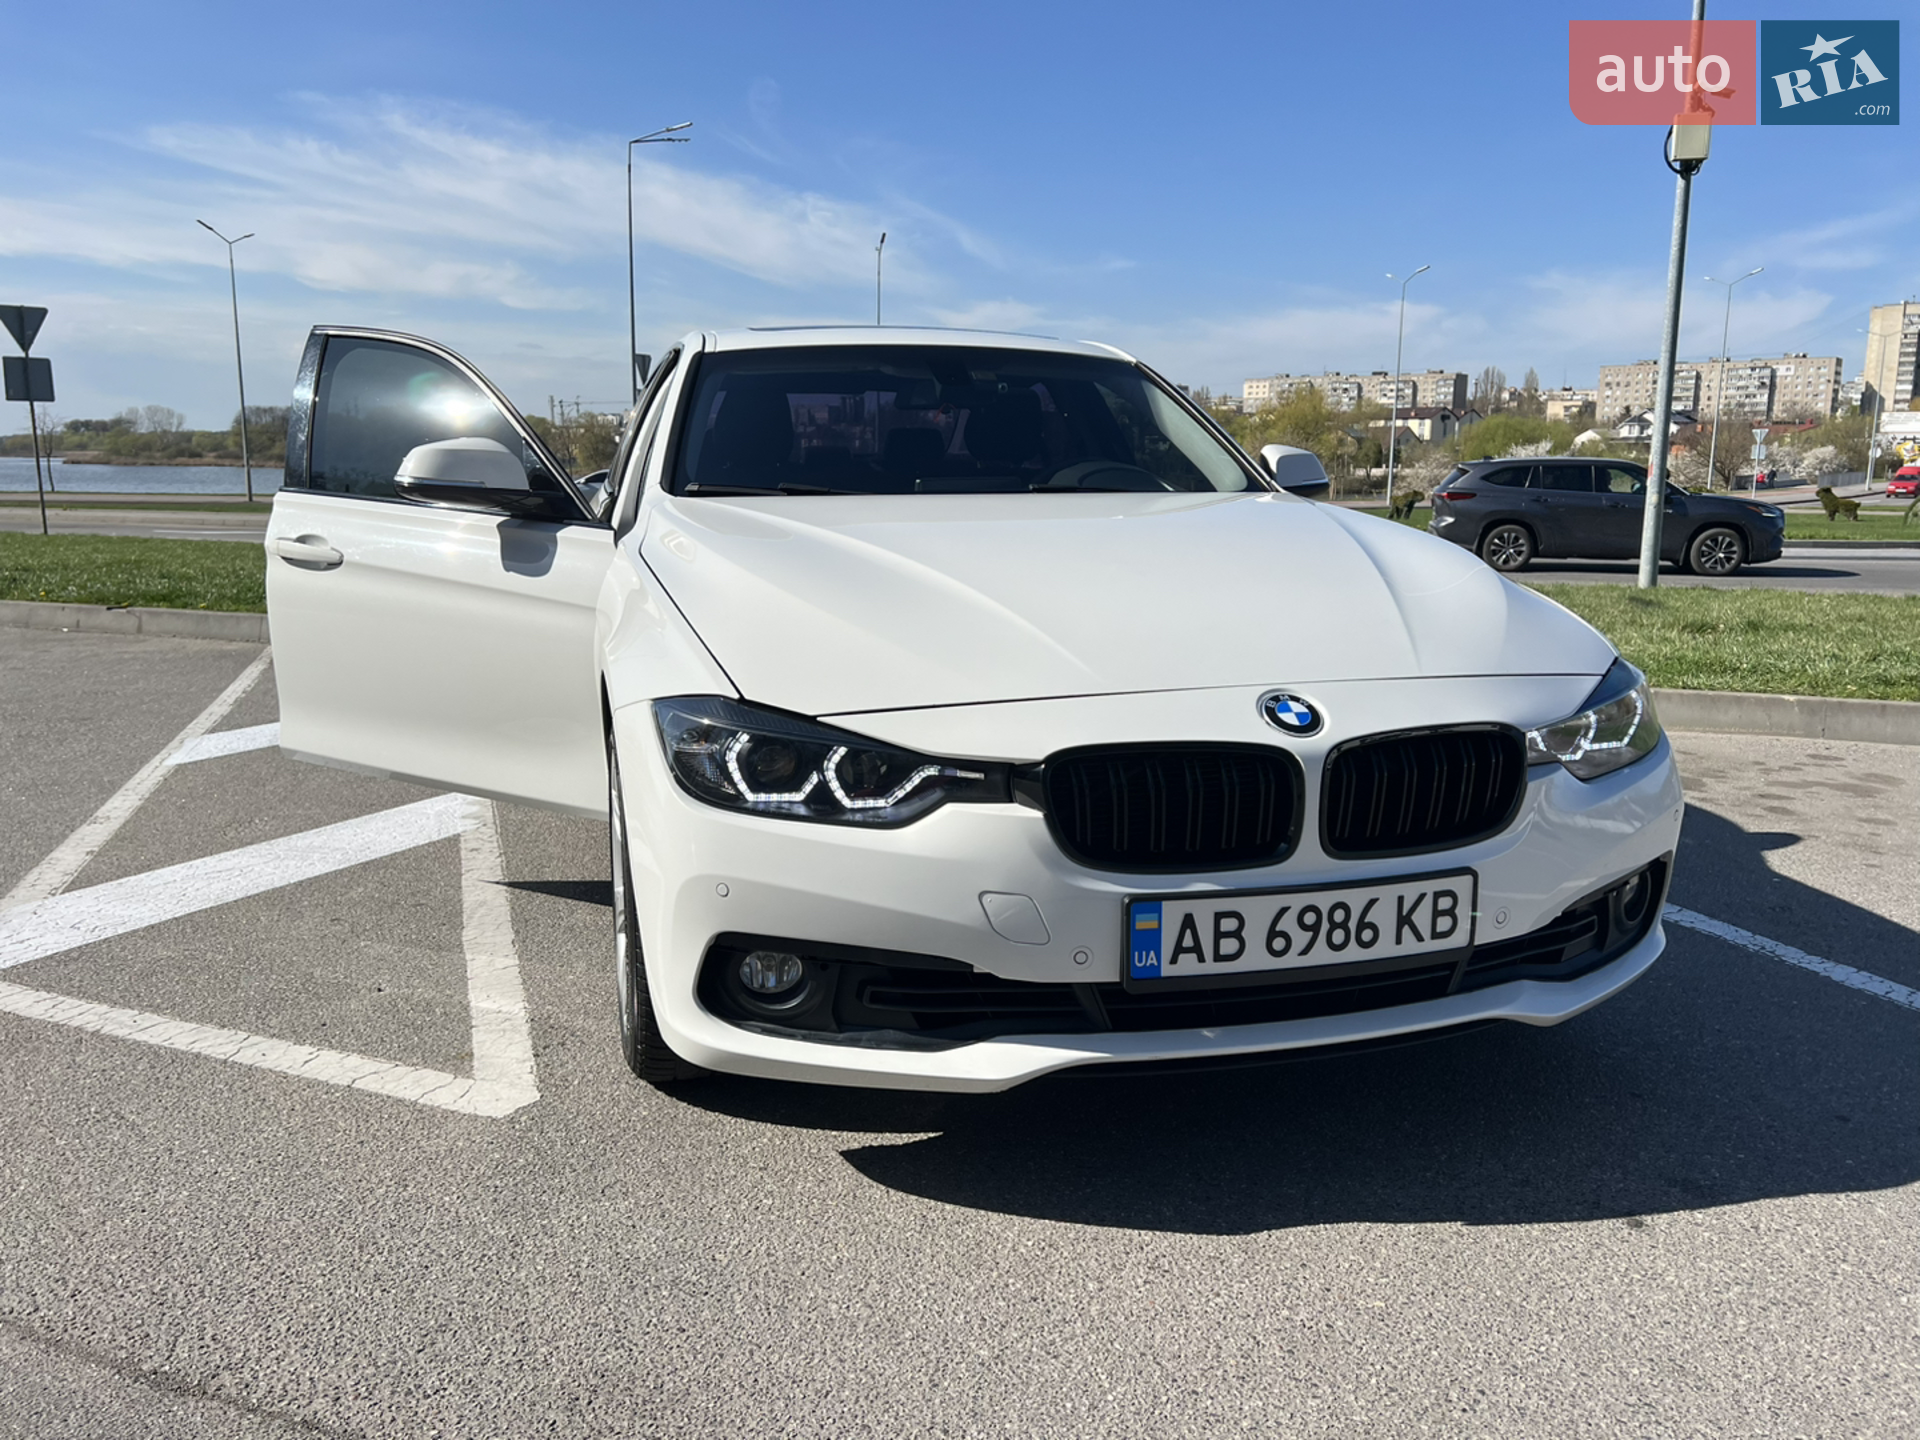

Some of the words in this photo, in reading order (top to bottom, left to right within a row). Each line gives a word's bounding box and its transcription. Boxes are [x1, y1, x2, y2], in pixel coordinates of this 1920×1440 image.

[1266, 694, 1309, 708] BMW
[1169, 911, 1246, 965] AB
[1265, 898, 1380, 958] 6986
[1395, 889, 1459, 945] KB
[1134, 951, 1158, 967] UA
